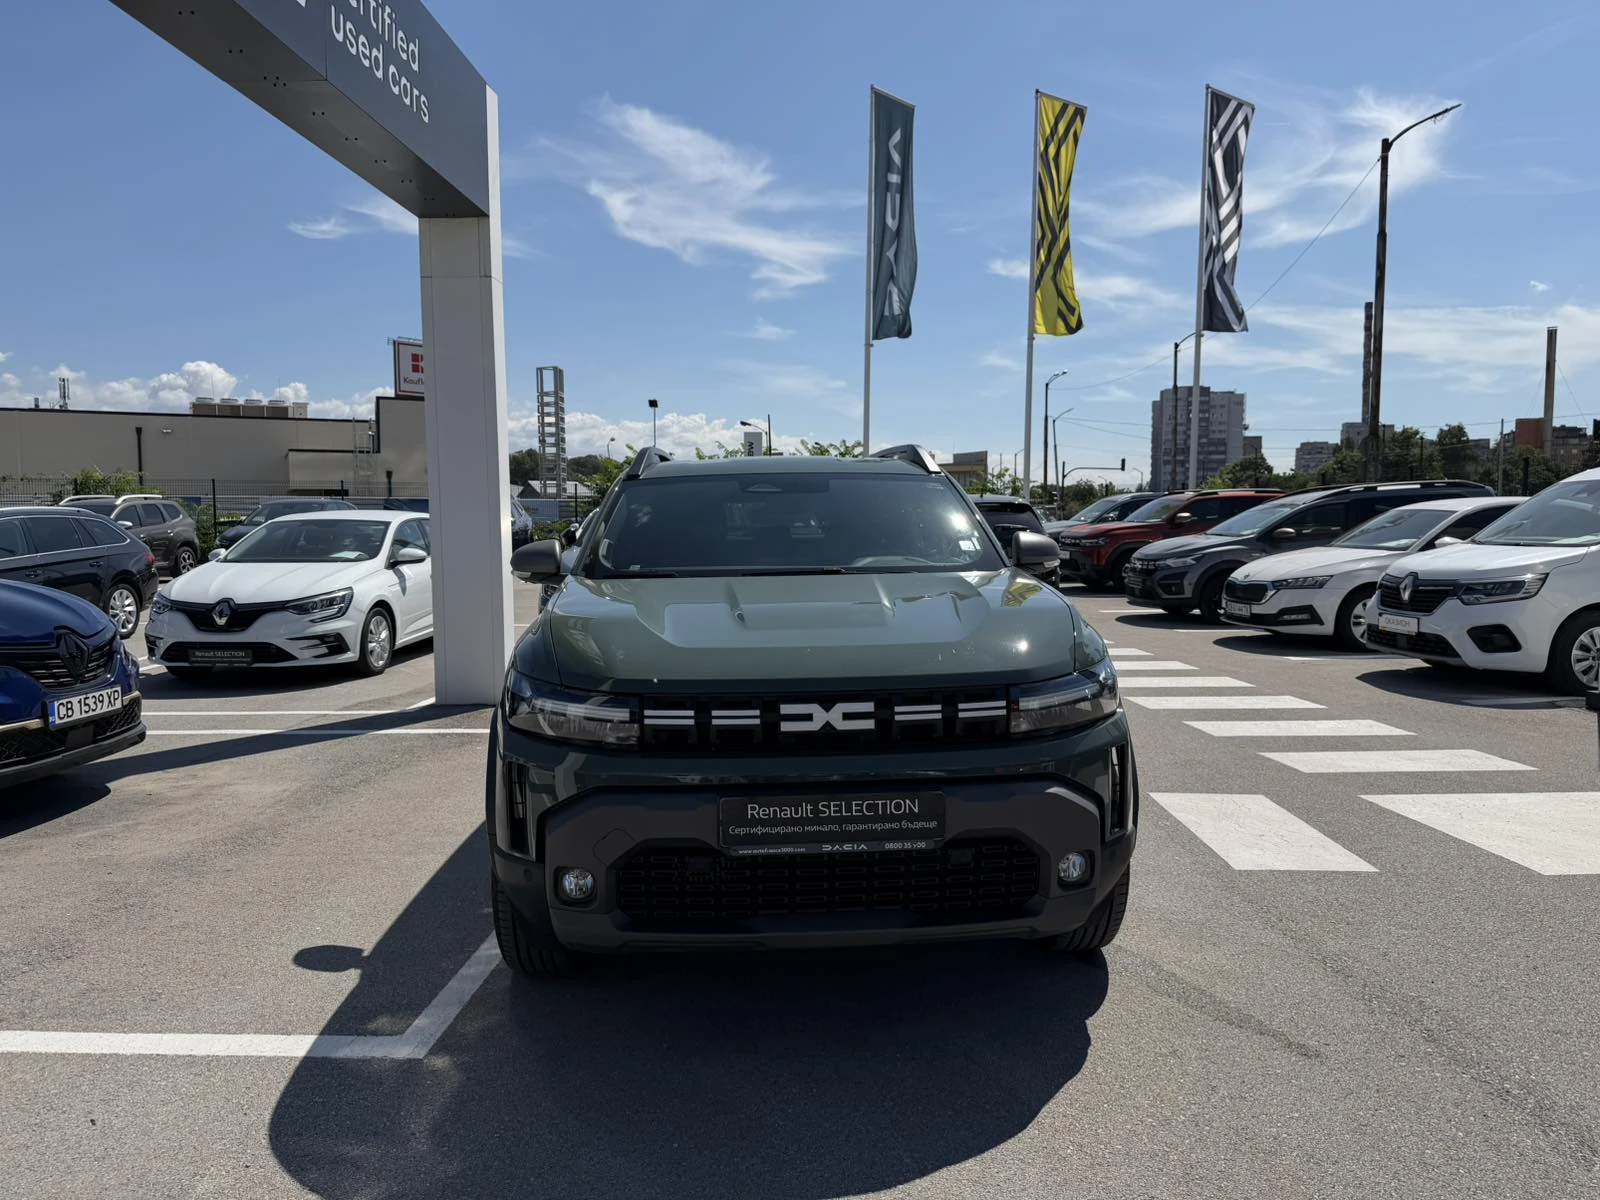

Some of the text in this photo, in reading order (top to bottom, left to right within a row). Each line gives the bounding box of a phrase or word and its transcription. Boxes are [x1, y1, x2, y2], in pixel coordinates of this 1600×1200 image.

[349, 0, 419, 73] tified
[331, 5, 429, 123] used cars
[403, 376, 424, 385] Kaufl
[57, 689, 120, 720] CB 1539 XP
[748, 799, 919, 819] Renault SELECTION
[728, 819, 938, 836] Сертифицирано минало, гарантирано бъдеще
